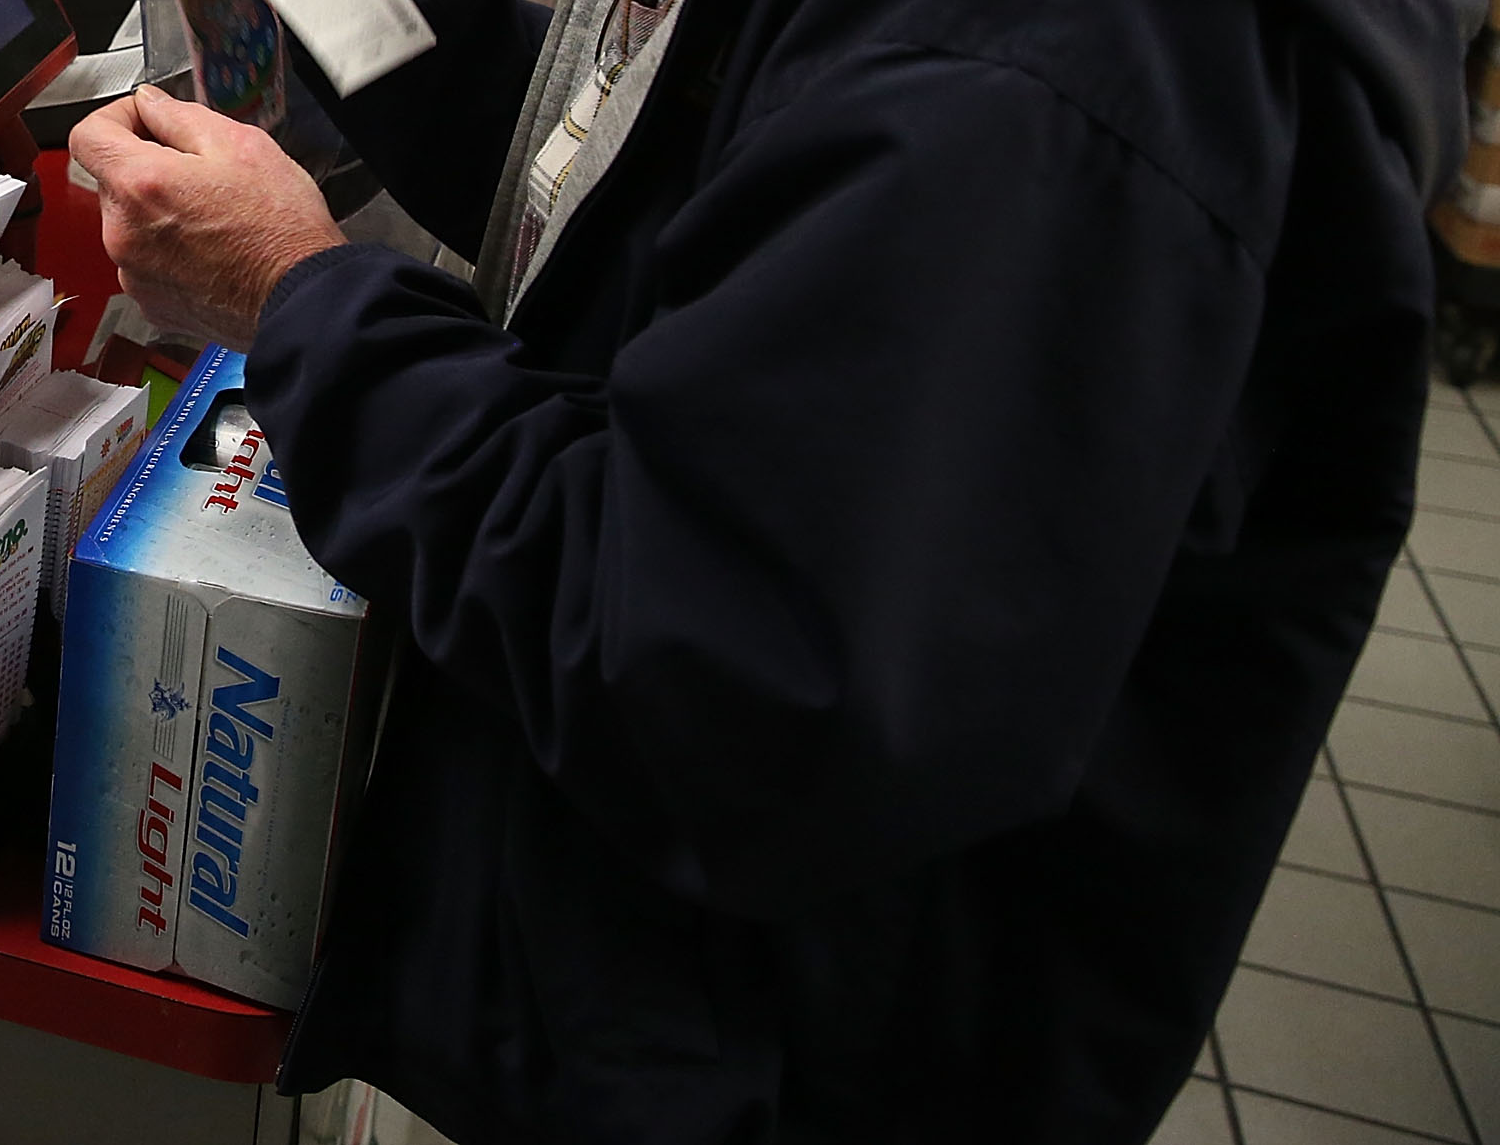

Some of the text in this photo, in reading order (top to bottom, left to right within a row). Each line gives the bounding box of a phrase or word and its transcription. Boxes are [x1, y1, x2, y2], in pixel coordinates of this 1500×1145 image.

[177, 400, 196, 428] WITH
[100, 482, 144, 542] INGREDIENTS
[188, 644, 281, 940] Natural
[54, 840, 77, 877] 12
[136, 761, 183, 936] Light
[50, 881, 62, 937] CANS
[64, 883, 73, 899] 12
